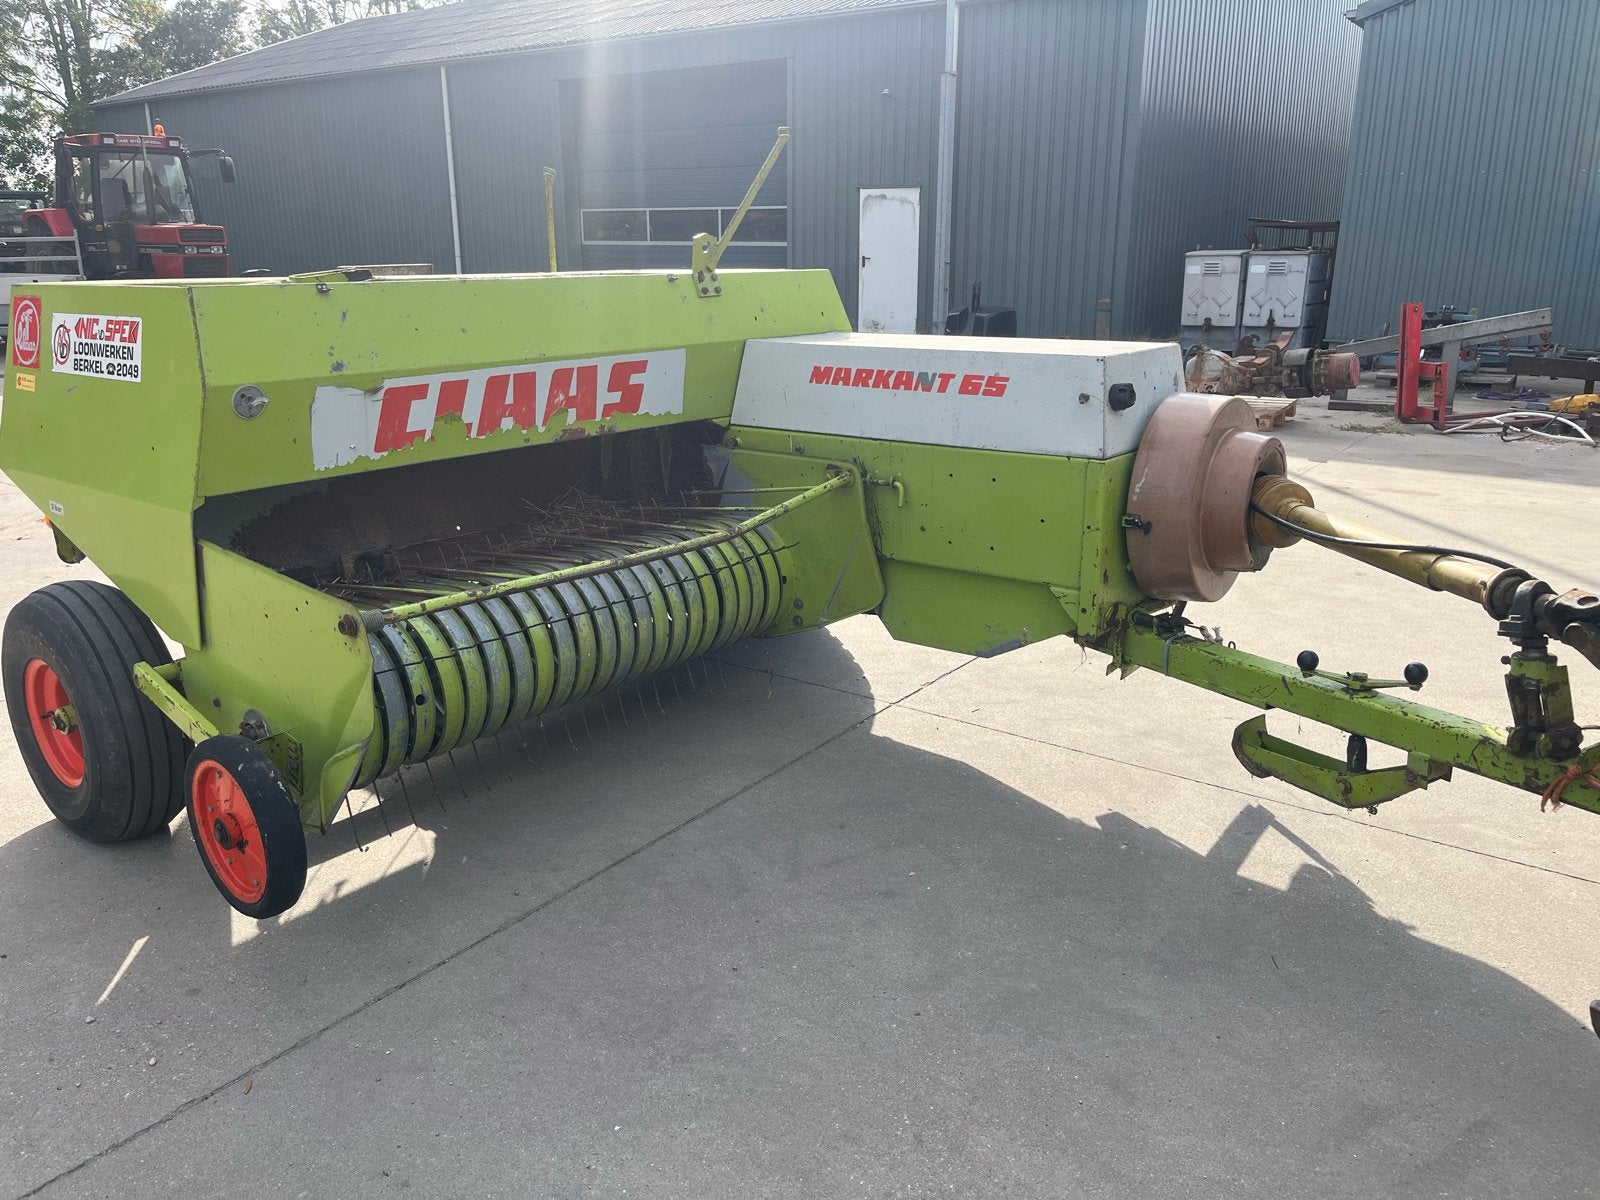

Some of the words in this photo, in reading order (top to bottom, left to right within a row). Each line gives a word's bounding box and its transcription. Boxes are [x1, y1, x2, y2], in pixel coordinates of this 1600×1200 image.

[75, 317, 99, 340] NIC
[74, 341, 134, 360] LOONWERKEN
[73, 358, 104, 374] BERKEL
[117, 362, 139, 378] 2049
[809, 365, 956, 394] MARKANT
[958, 374, 1010, 398] 65
[374, 360, 648, 453] CLAAS
